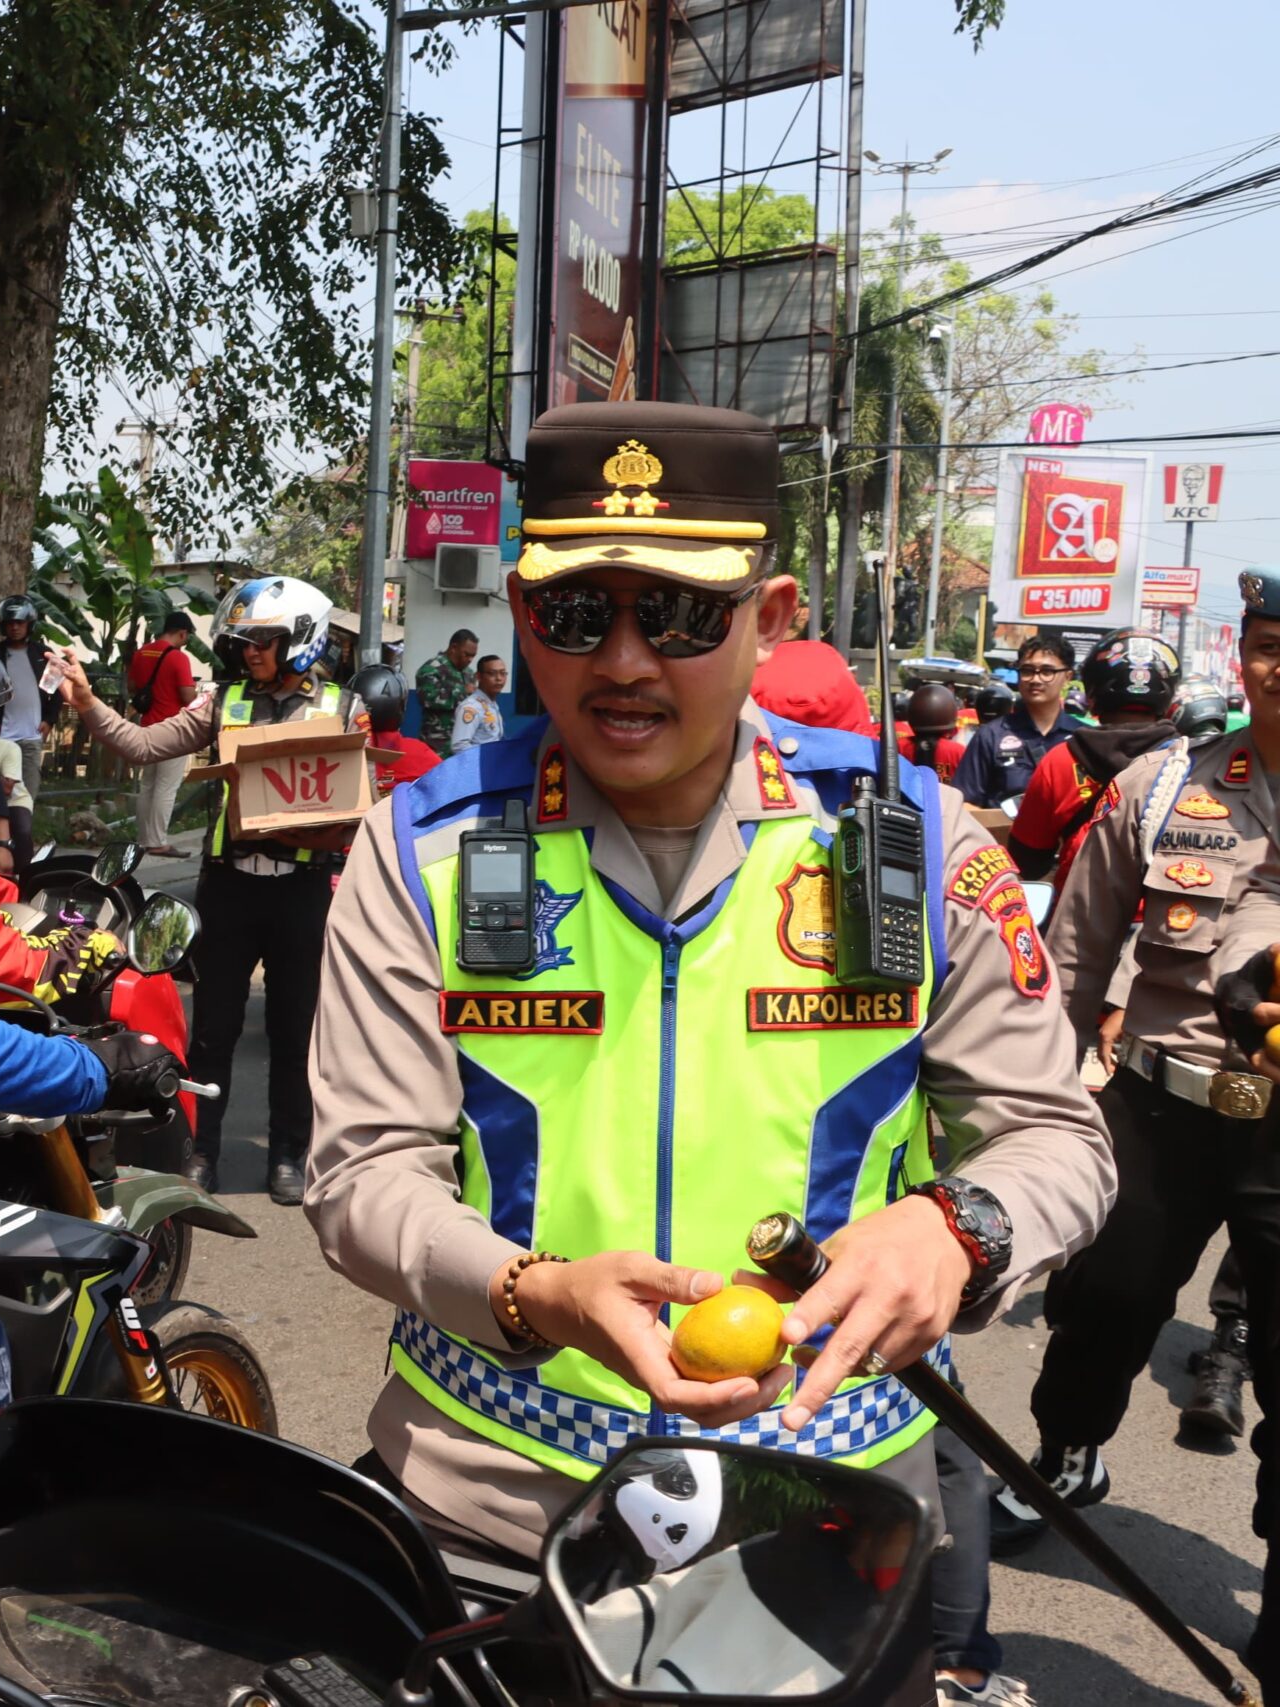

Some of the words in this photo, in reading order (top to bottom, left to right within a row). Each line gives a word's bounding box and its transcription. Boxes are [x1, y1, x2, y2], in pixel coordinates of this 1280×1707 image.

[575, 123, 621, 229] ELITE
[568, 219, 581, 261] RP
[582, 233, 621, 314] 18.000
[1028, 460, 1061, 474] NEW
[417, 487, 496, 504] martfren
[1172, 506, 1210, 518] KFC
[1143, 570, 1194, 582] Alfamart
[1042, 588, 1103, 610] 35.000
[261, 756, 340, 804] Vit
[483, 844, 507, 852] Hytera
[456, 999, 589, 1027] ARIEK
[766, 993, 903, 1023] KAPOLRES
